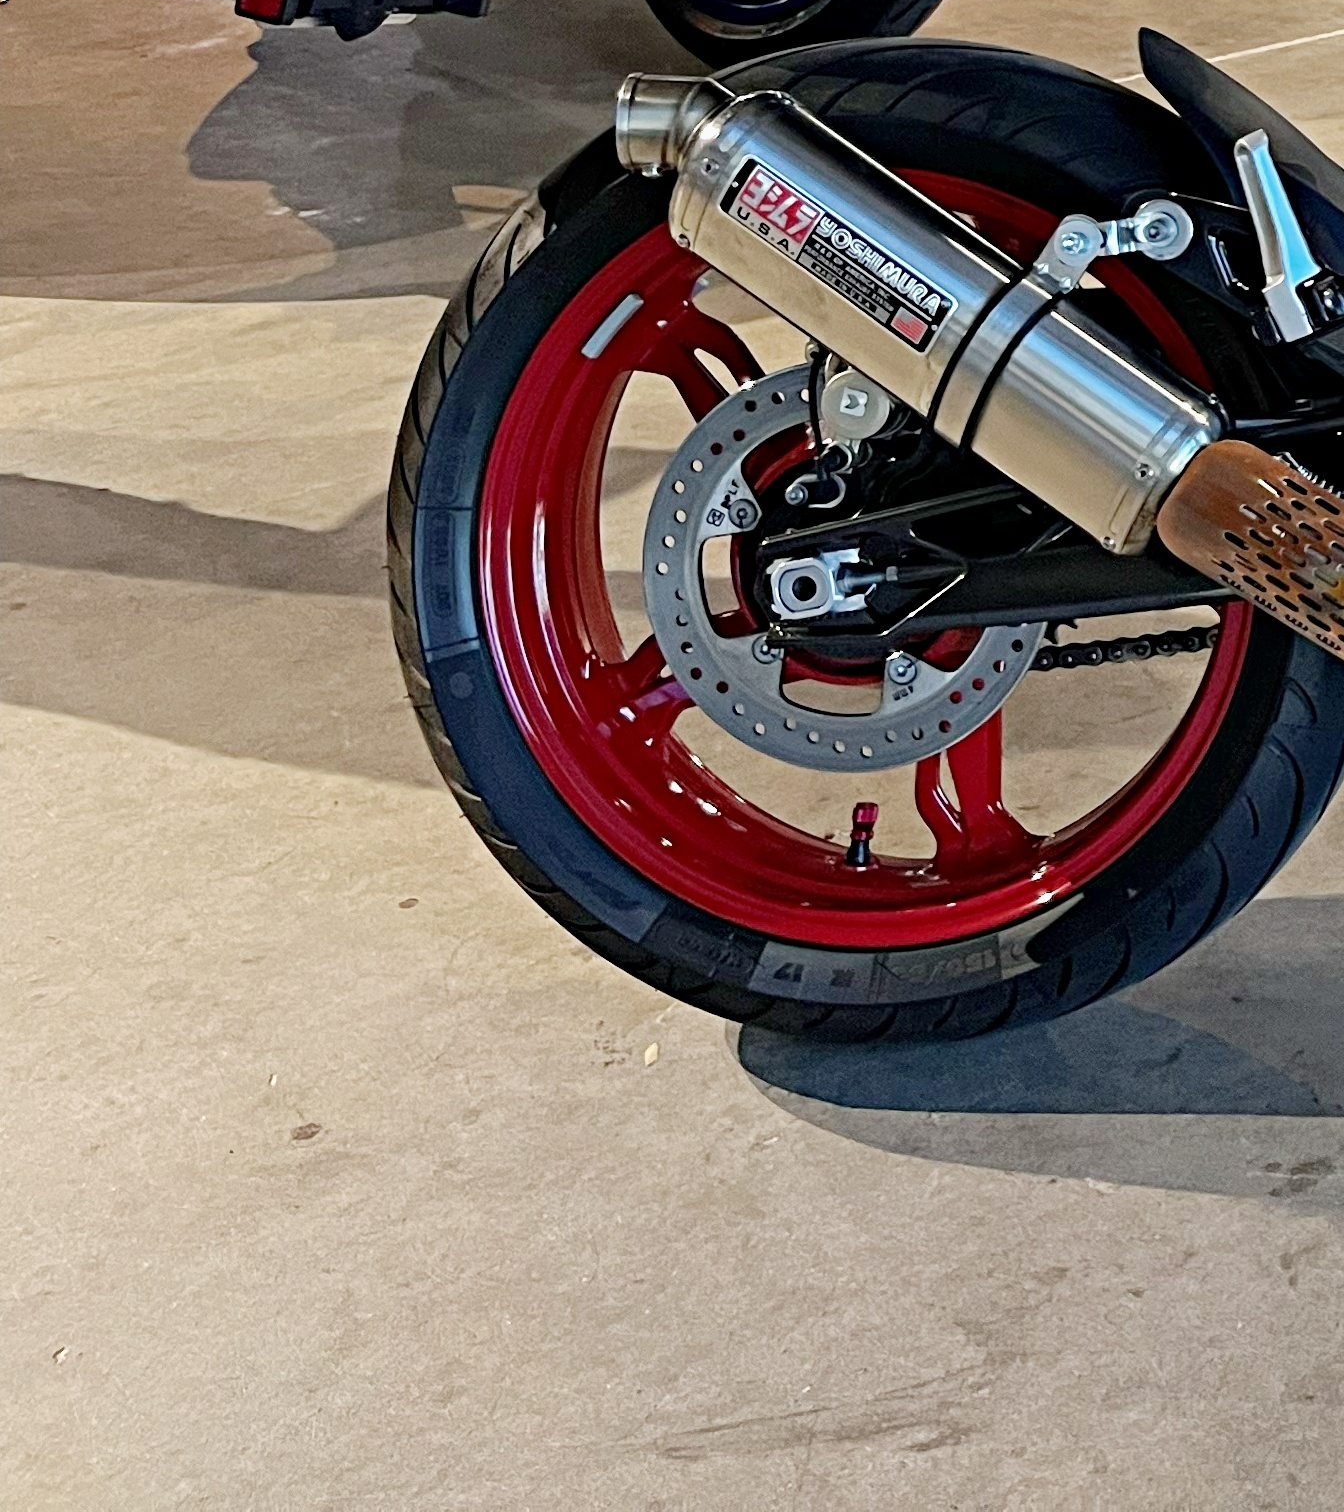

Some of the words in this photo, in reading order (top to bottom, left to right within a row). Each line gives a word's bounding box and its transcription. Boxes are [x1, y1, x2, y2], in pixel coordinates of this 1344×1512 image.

[741, 171, 818, 236] ヨシムラ
[813, 215, 942, 317] YOSHIMURA
